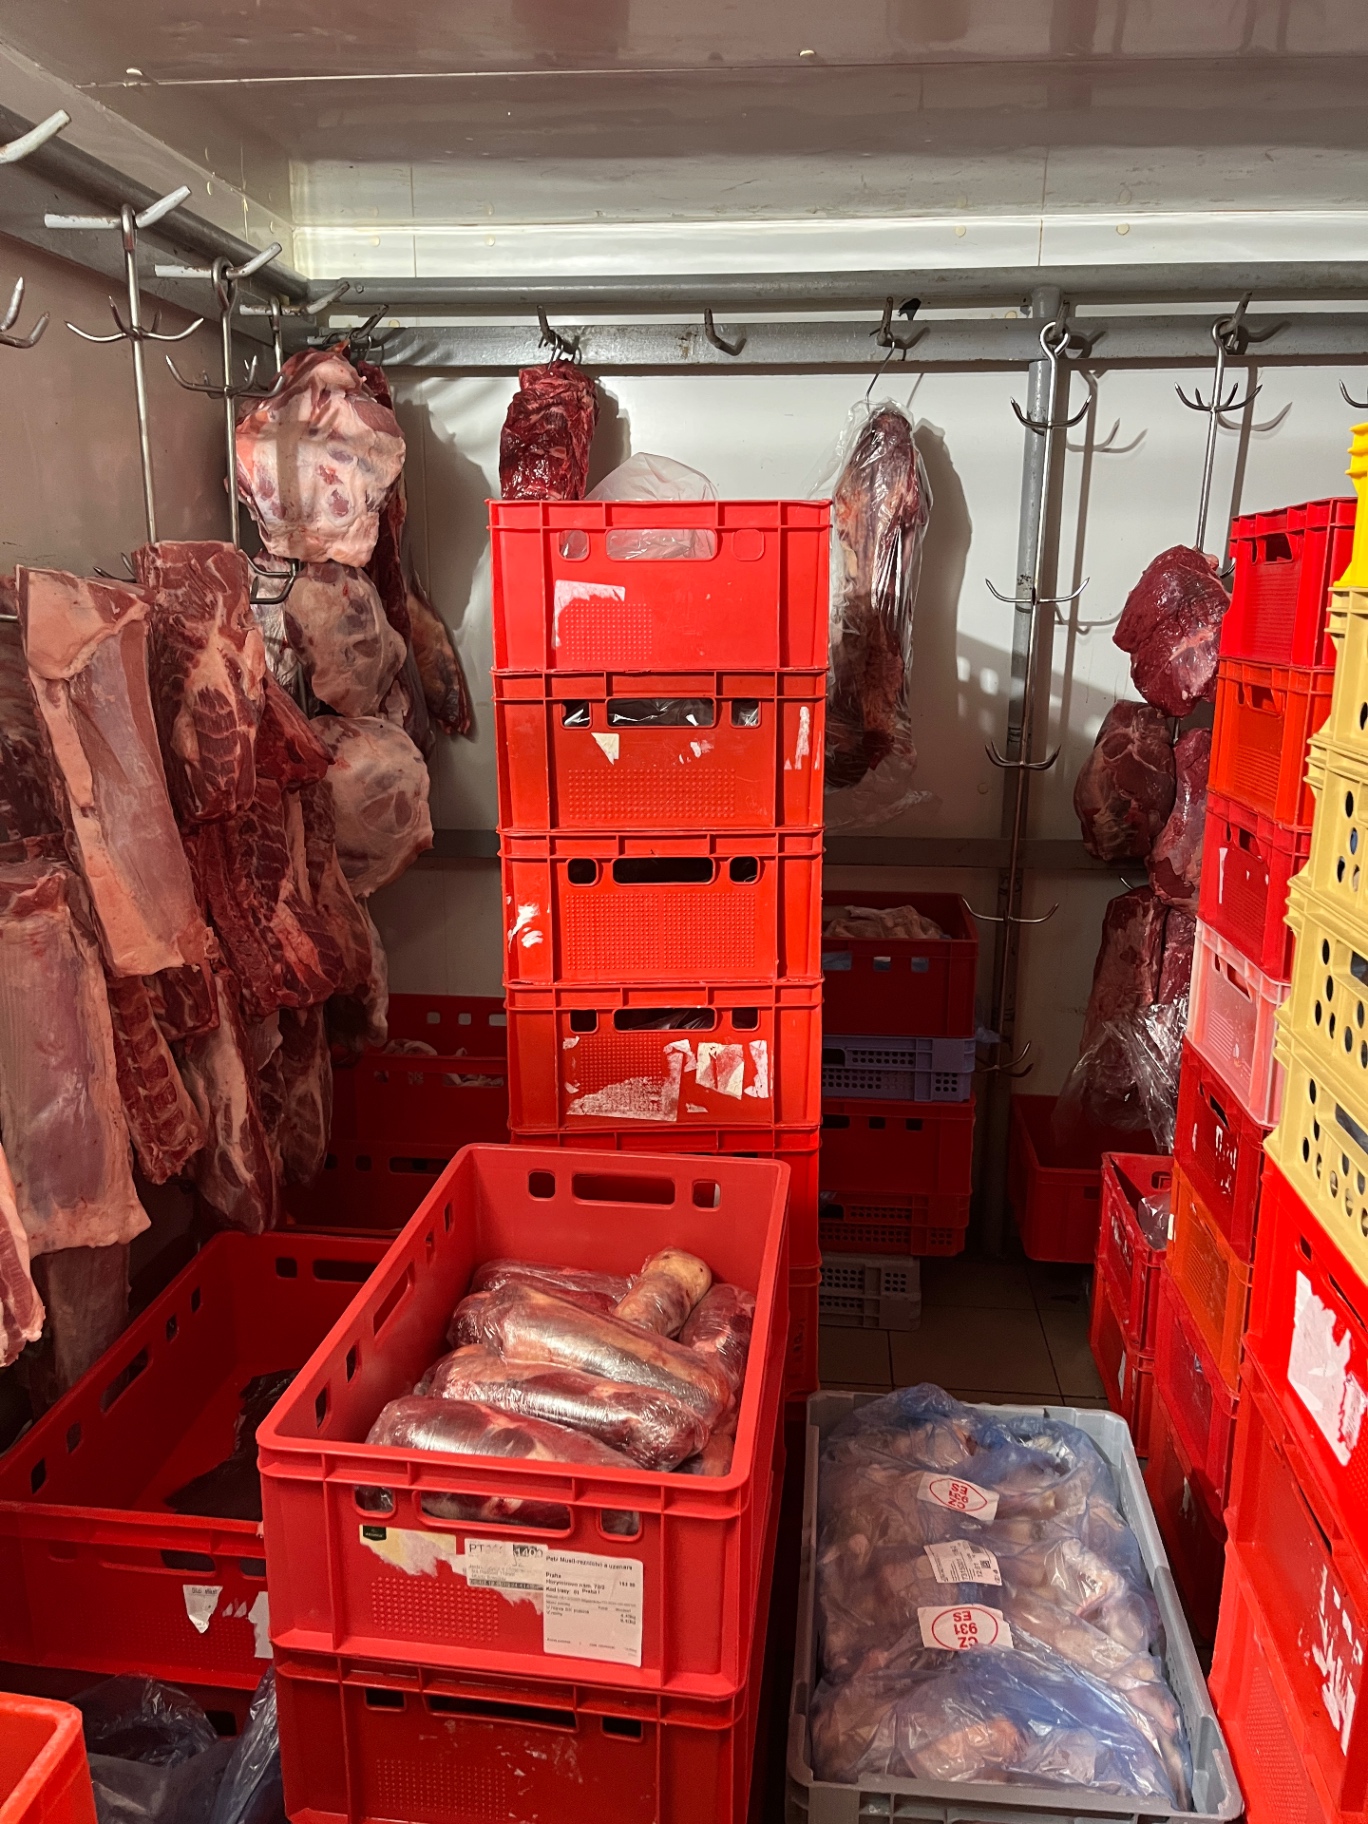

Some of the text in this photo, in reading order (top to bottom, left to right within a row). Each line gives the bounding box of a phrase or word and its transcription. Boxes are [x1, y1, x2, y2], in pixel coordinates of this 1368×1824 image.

[951, 1483, 968, 1495] ES
[948, 1490, 969, 1503] 931
[947, 1498, 966, 1510] CZ
[952, 1610, 972, 1622] ES
[953, 1622, 978, 1635] 931
